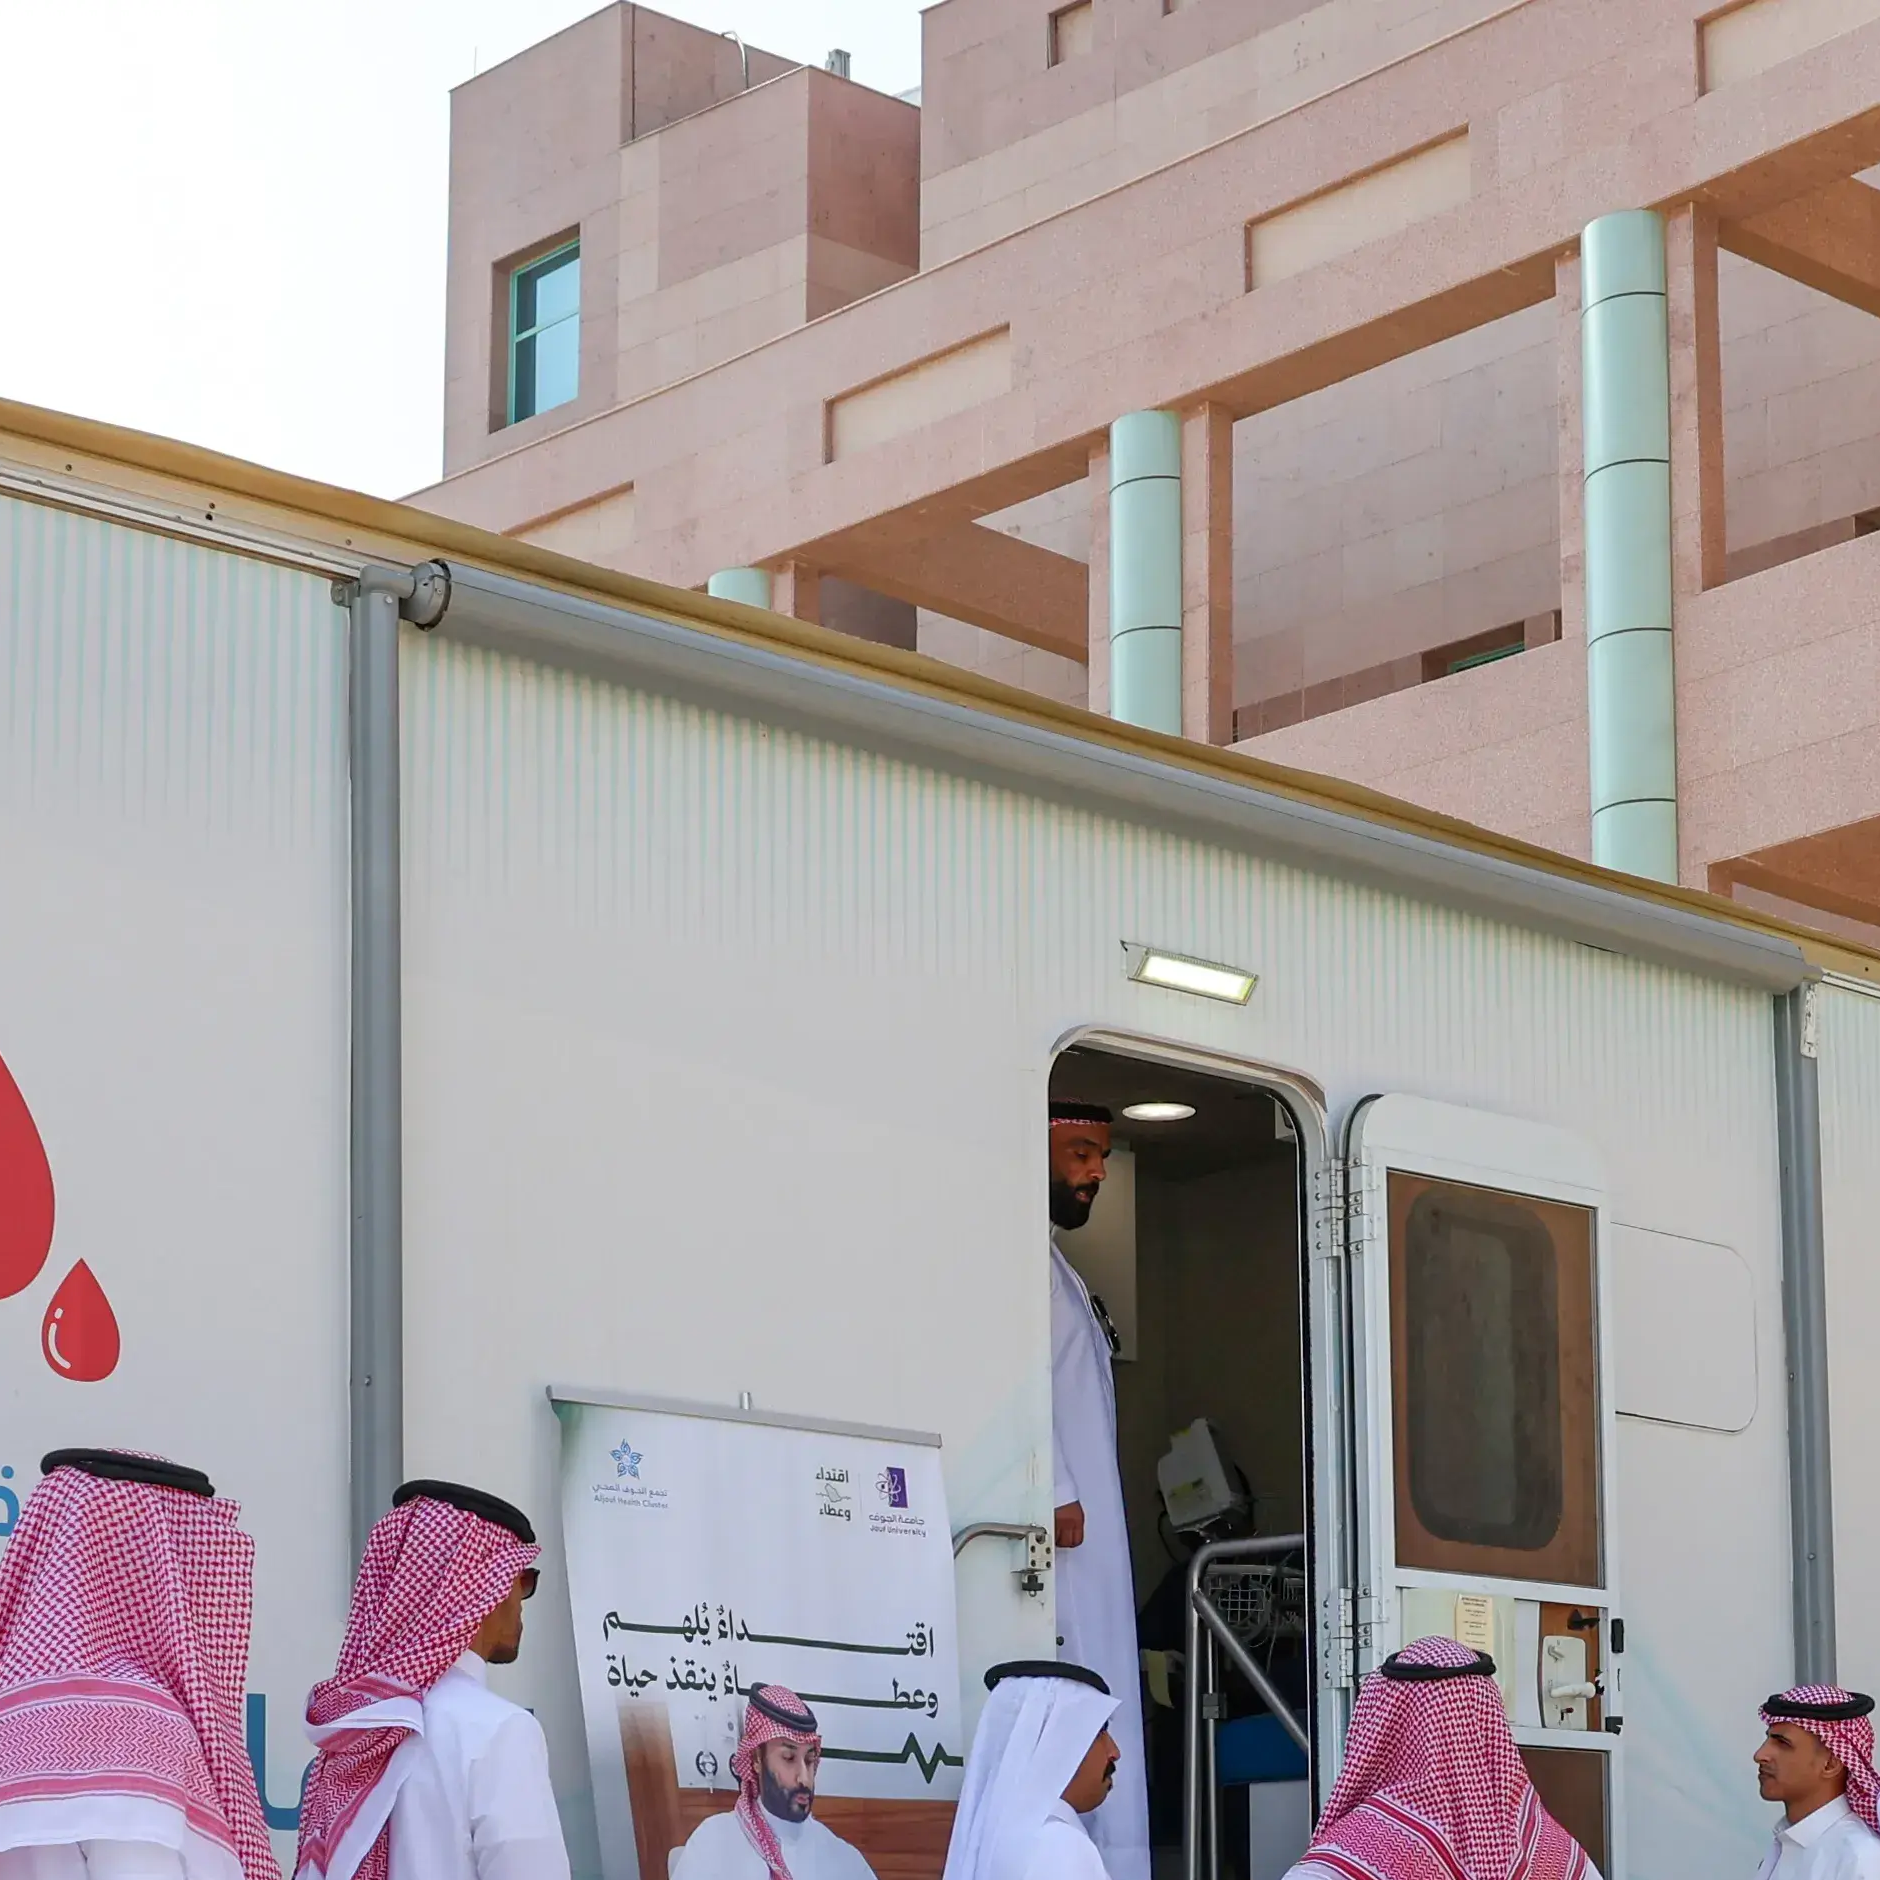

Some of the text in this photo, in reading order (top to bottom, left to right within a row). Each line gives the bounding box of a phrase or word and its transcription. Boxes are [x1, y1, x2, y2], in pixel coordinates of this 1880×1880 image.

[815, 1465, 850, 1483] اقتداء
[818, 1502, 852, 1522] وعطاء
[887, 1526, 926, 1538] University
[605, 1654, 658, 1698] حياة
[665, 1655, 718, 1702] ينقذ
